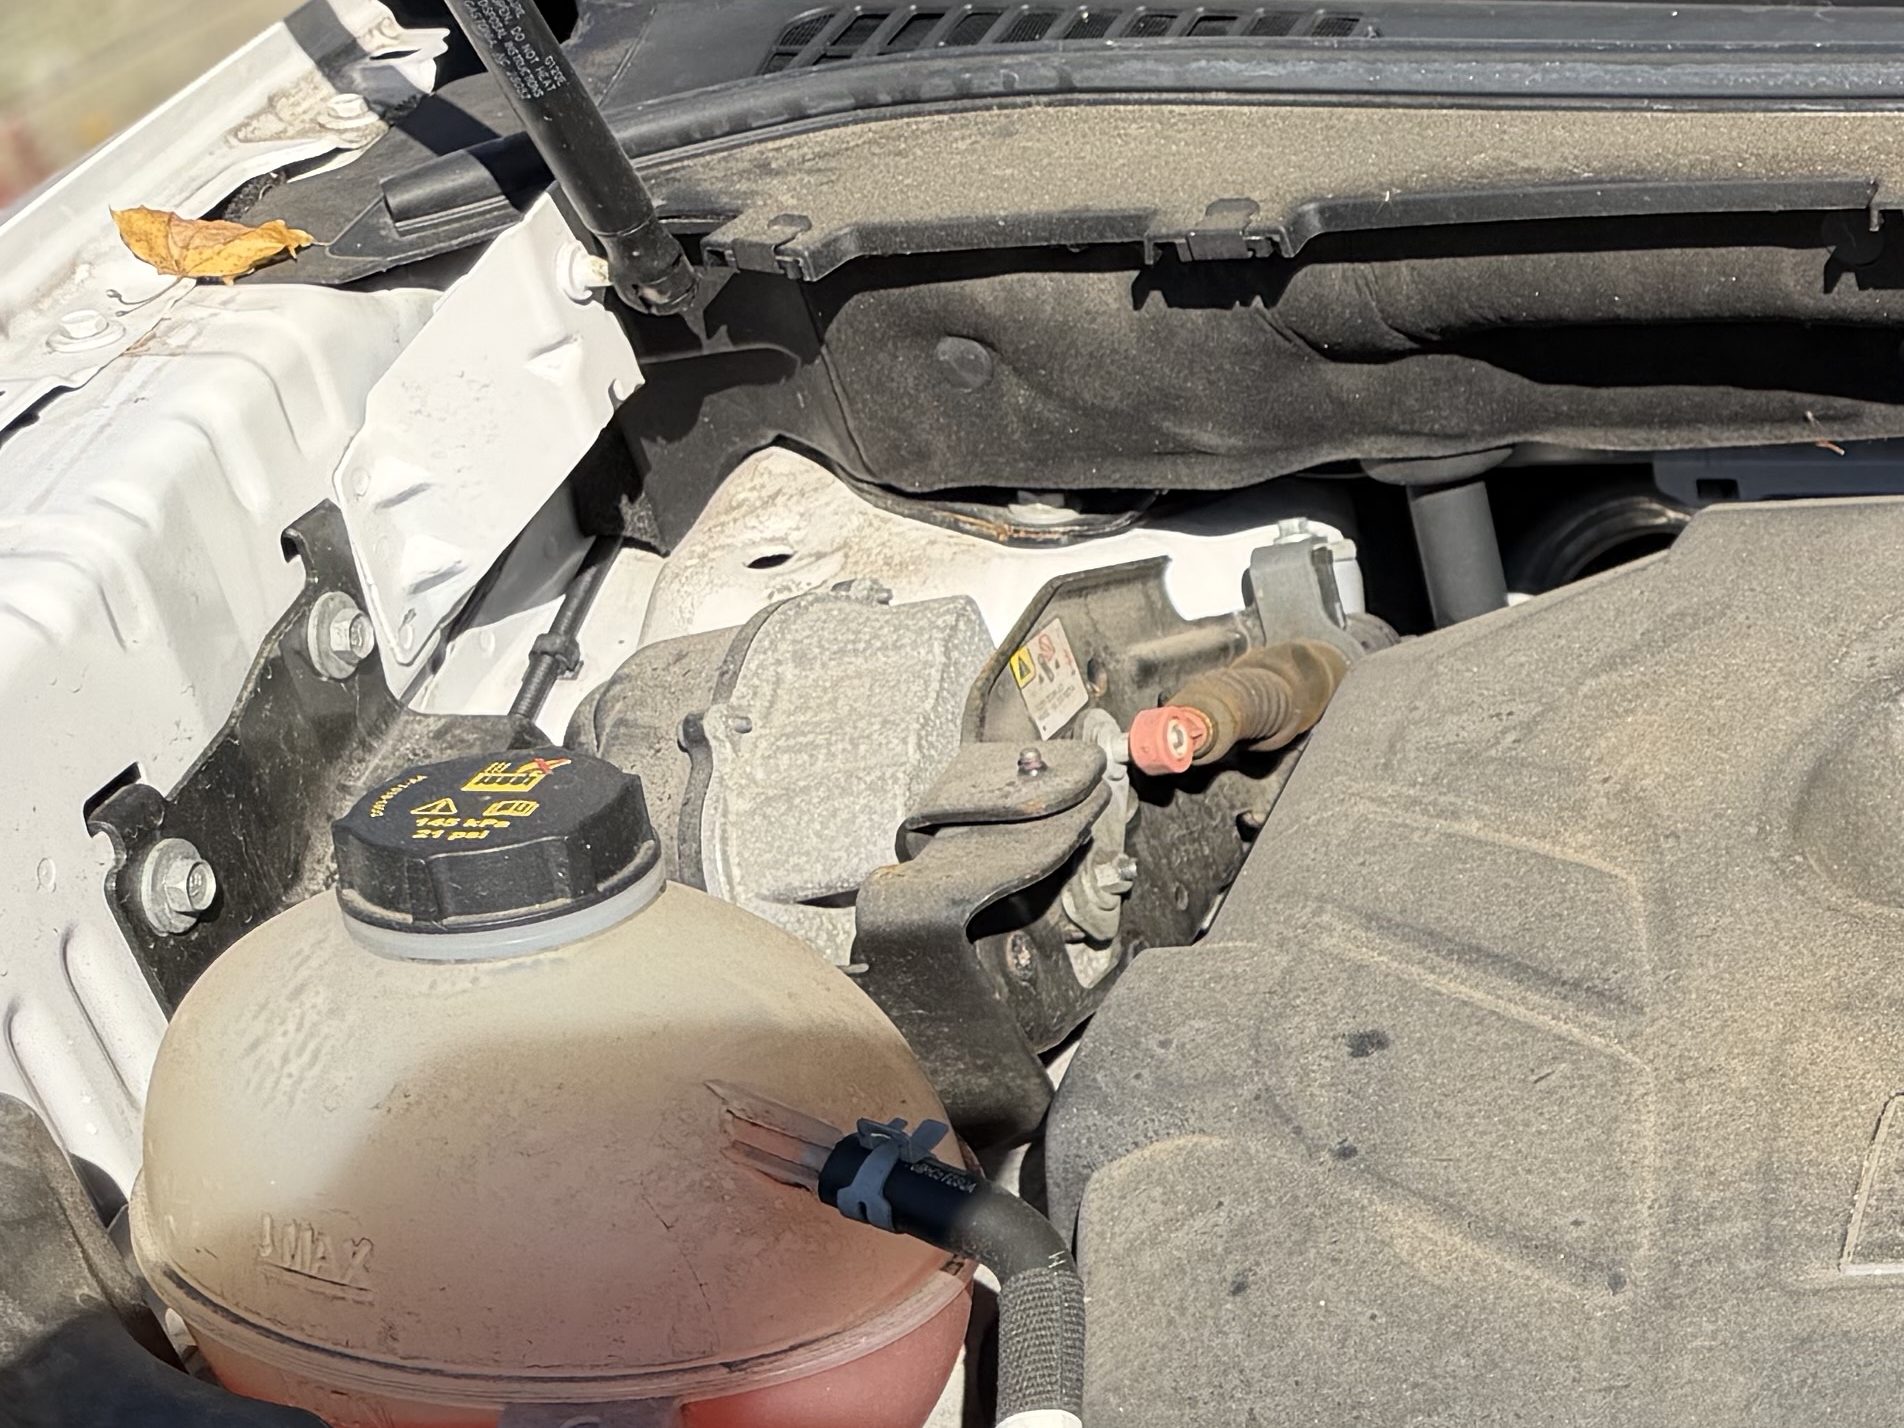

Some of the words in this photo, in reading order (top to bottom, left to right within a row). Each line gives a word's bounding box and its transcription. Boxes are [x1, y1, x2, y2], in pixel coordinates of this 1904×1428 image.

[477, 0, 508, 39] DISPOSAL
[503, 40, 545, 99] INSTRUCTIONS
[510, 25, 526, 42] DO
[521, 42, 540, 64] NOT
[535, 66, 558, 92] HEAT
[412, 829, 445, 839] 21
[416, 817, 461, 827] 145
